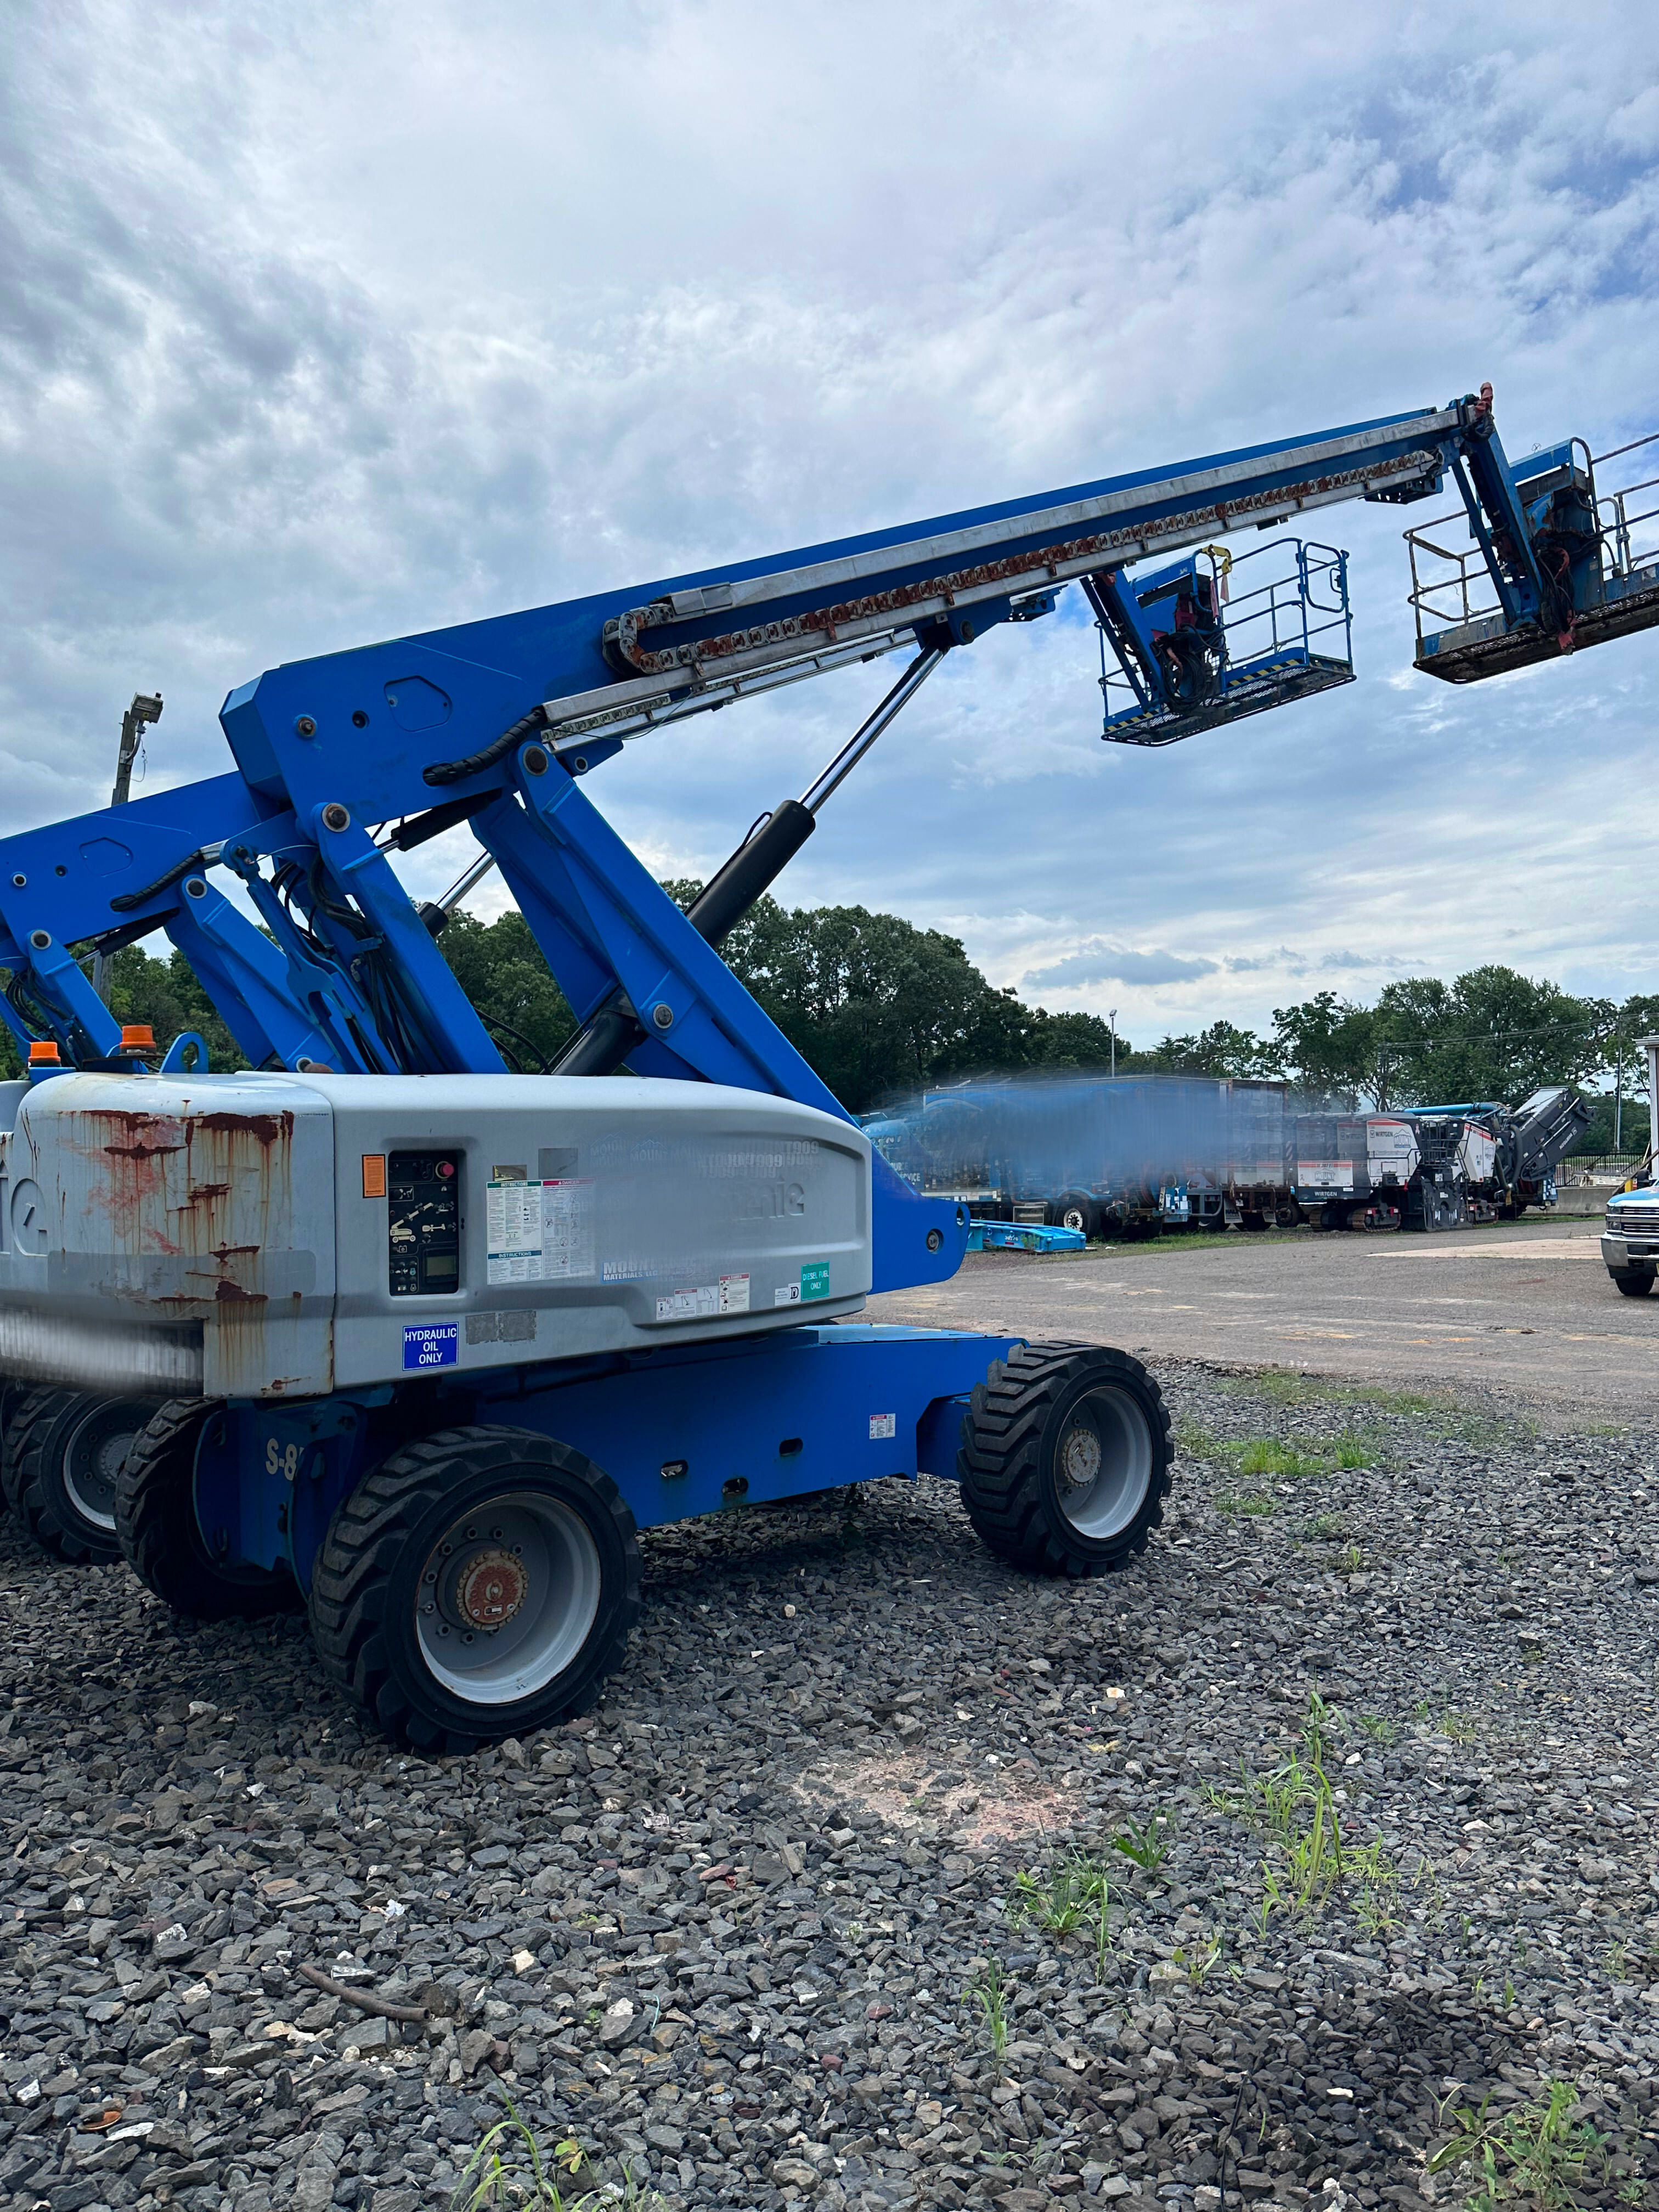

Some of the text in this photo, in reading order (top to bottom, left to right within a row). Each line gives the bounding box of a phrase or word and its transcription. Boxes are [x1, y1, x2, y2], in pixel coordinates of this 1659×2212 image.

[803, 1269, 830, 1281] DIESEL FUEL
[810, 1281, 822, 1290] ONLY
[405, 1328, 457, 1342] HYDRAULIC
[423, 1341, 438, 1352] OIL
[419, 1352, 443, 1364] ONLY
[266, 1438, 304, 1481] S-8
